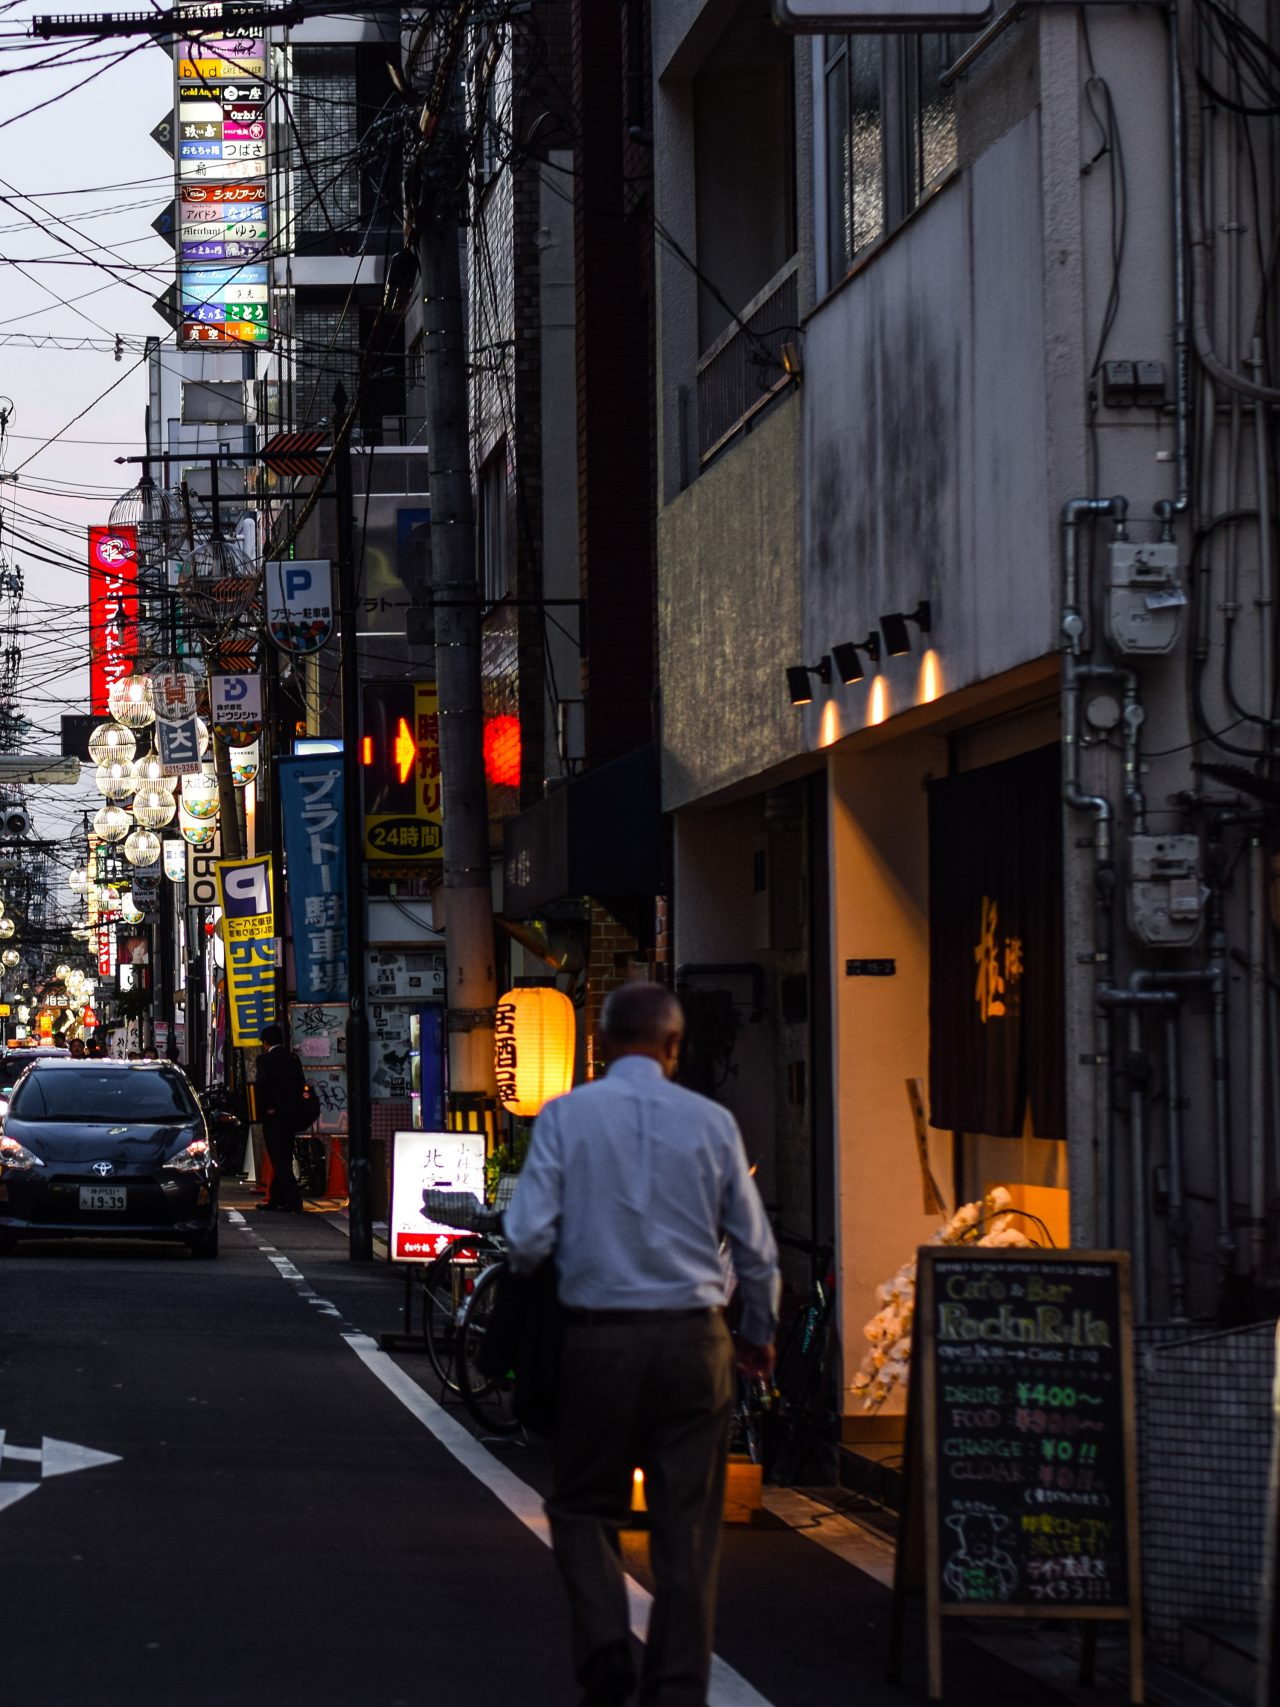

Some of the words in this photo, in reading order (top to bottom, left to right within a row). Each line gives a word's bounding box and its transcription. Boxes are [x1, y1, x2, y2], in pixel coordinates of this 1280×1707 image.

[181, 88, 198, 96] Gold
[224, 144, 262, 156] つばさ
[231, 305, 264, 320] ことう
[286, 569, 312, 600] P
[164, 763, 199, 774] 6211-3268
[373, 827, 441, 848] 24時間
[297, 775, 350, 997] プラトー駐車場
[1026, 1273, 1073, 1302] Bar
[951, 1408, 1001, 1428] FOOD
[942, 1437, 1024, 1457] CHARGE
